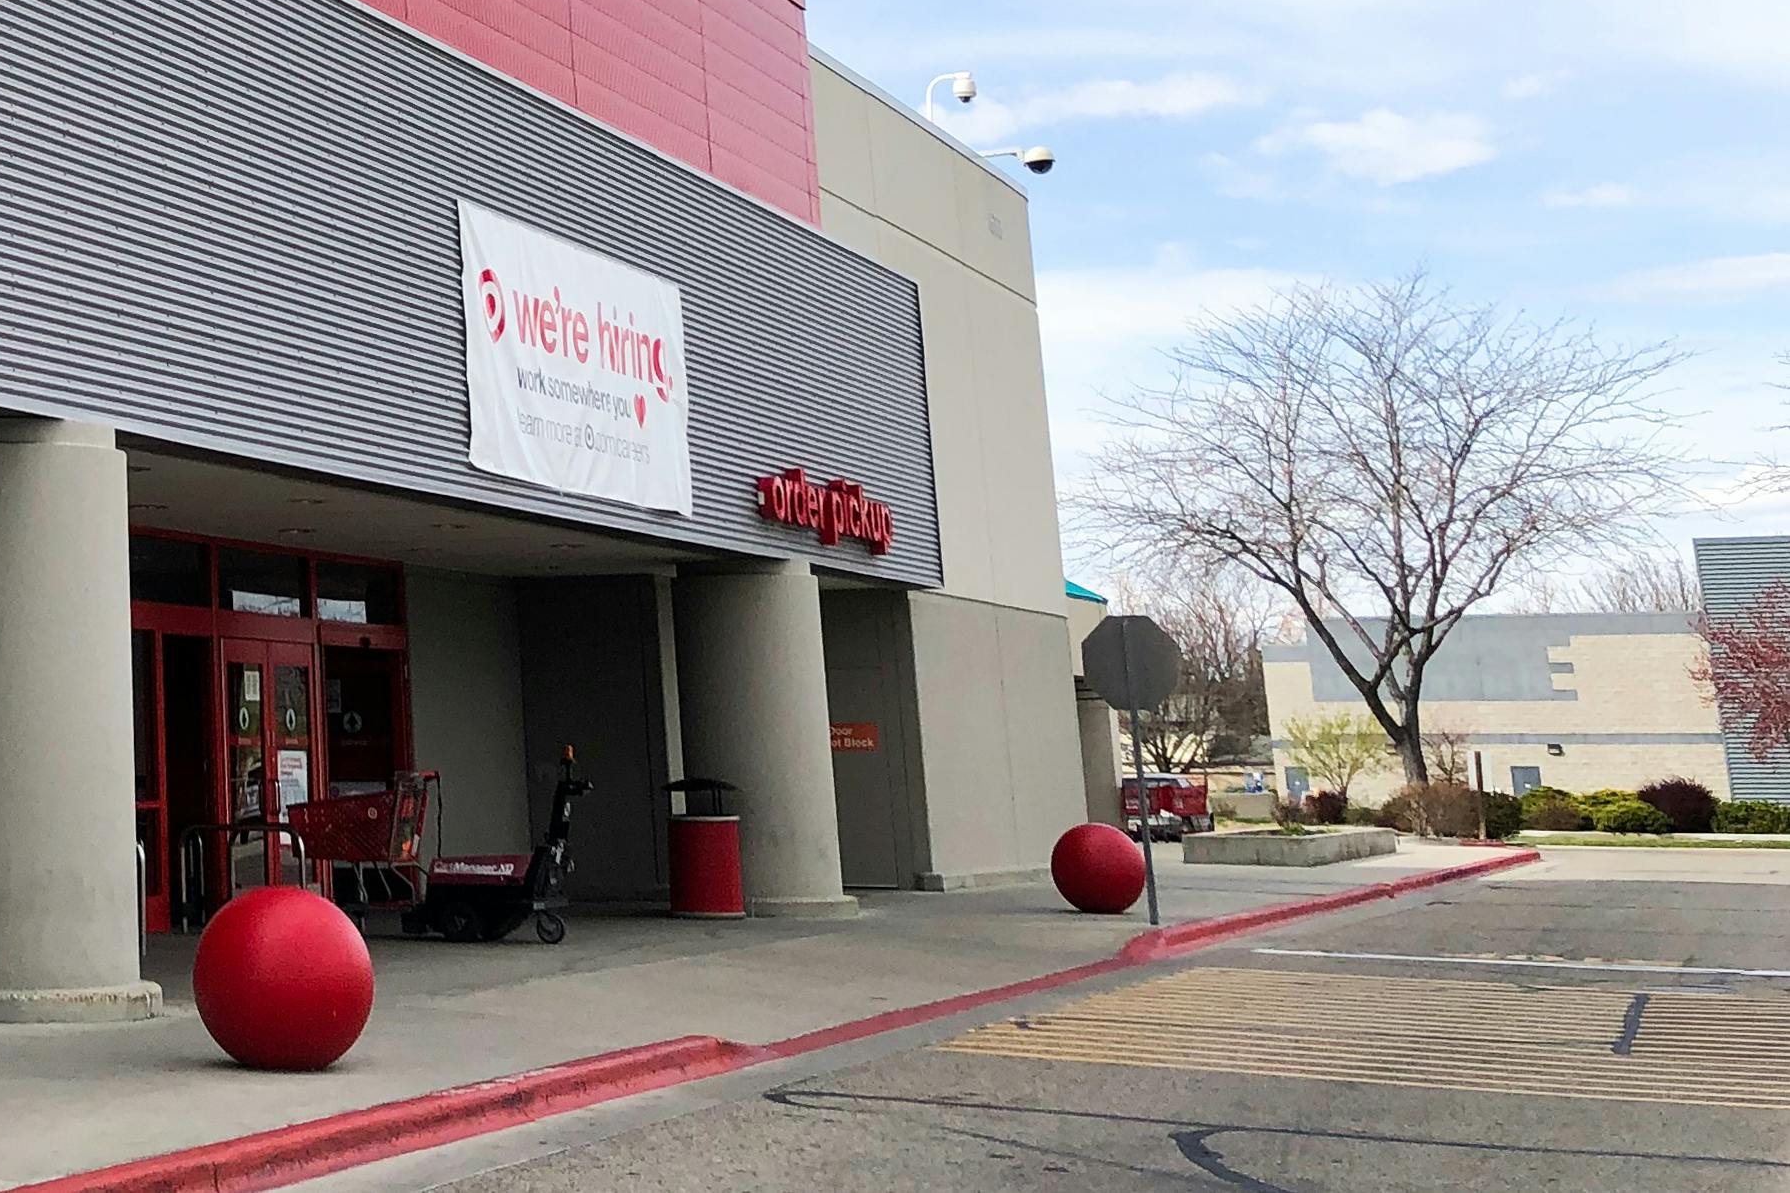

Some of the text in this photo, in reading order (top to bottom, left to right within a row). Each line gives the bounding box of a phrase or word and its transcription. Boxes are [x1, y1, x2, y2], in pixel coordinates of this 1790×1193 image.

[512, 285, 673, 403] we're hiring.
[516, 366, 631, 421] work somewhere you
[516, 406, 544, 438] learn
[546, 418, 573, 446] more
[766, 468, 892, 555] order pickup
[831, 737, 875, 748] ot Block
